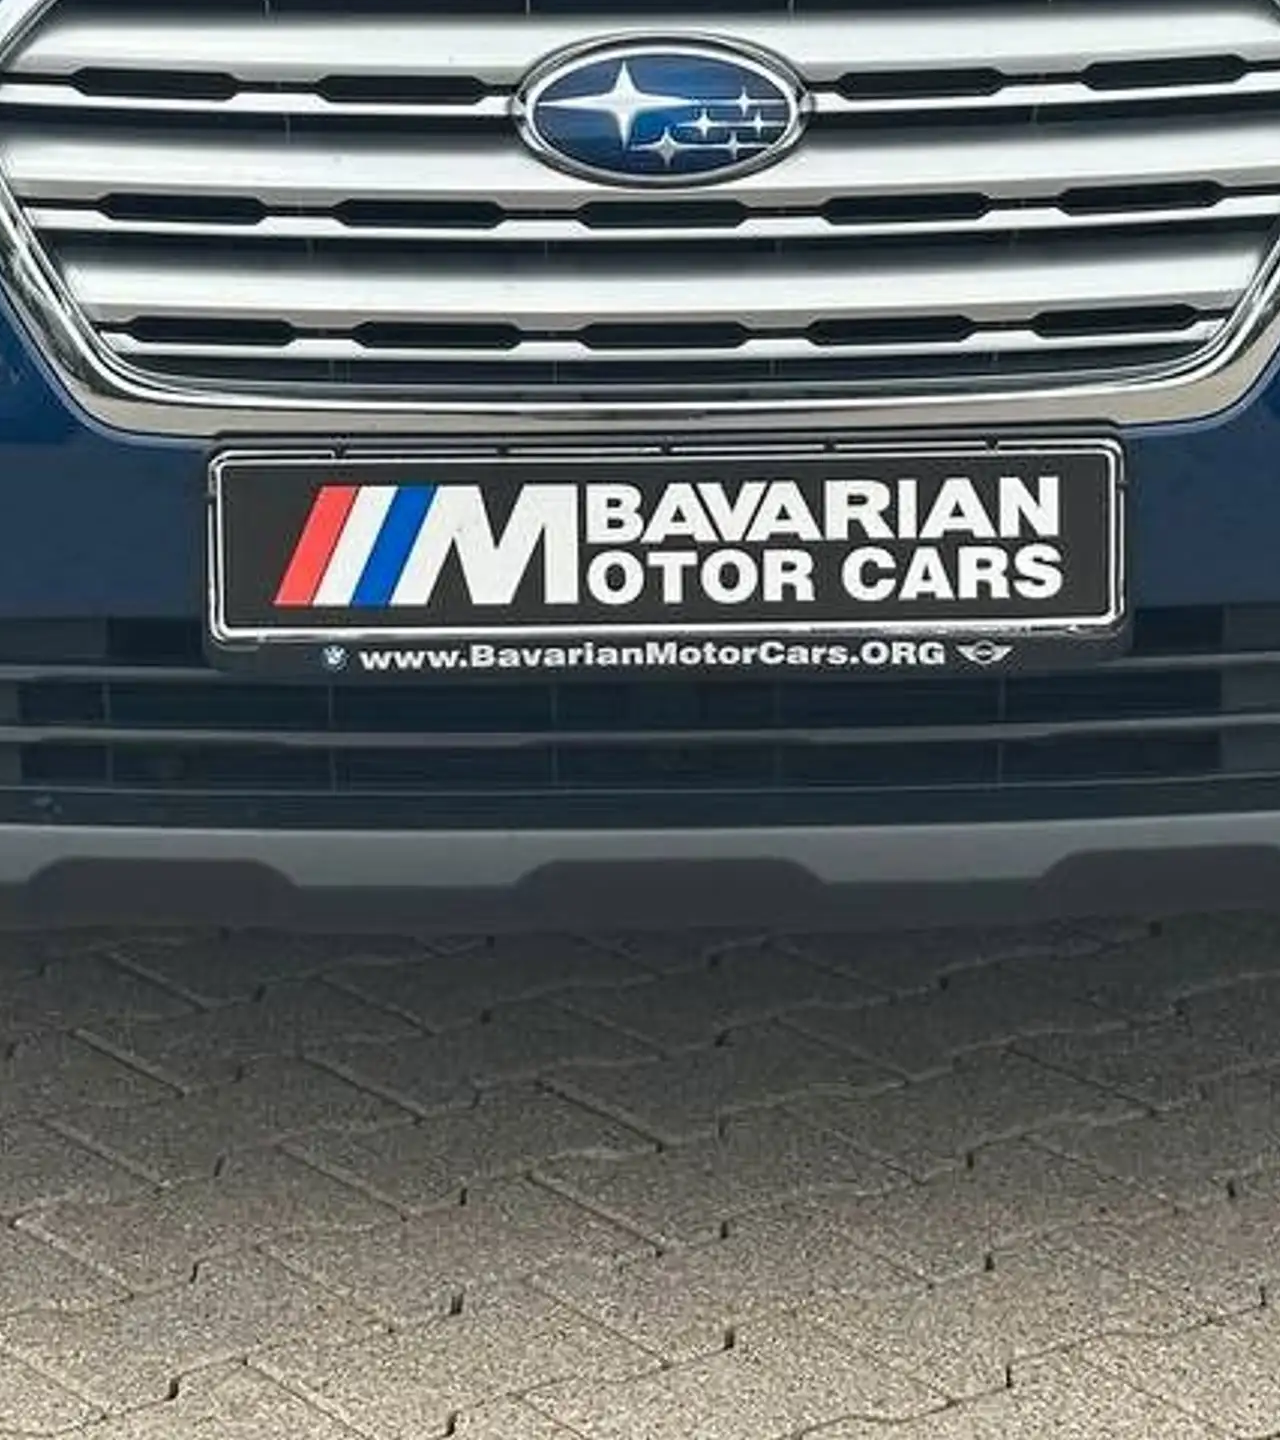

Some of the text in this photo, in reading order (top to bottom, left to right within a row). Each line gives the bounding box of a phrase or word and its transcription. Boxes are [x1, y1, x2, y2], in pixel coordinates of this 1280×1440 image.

[586, 476, 1060, 544] BAVARIAN
[841, 542, 1064, 602] CARS
[359, 640, 946, 670] www.BavarianMotorCars.ORG
